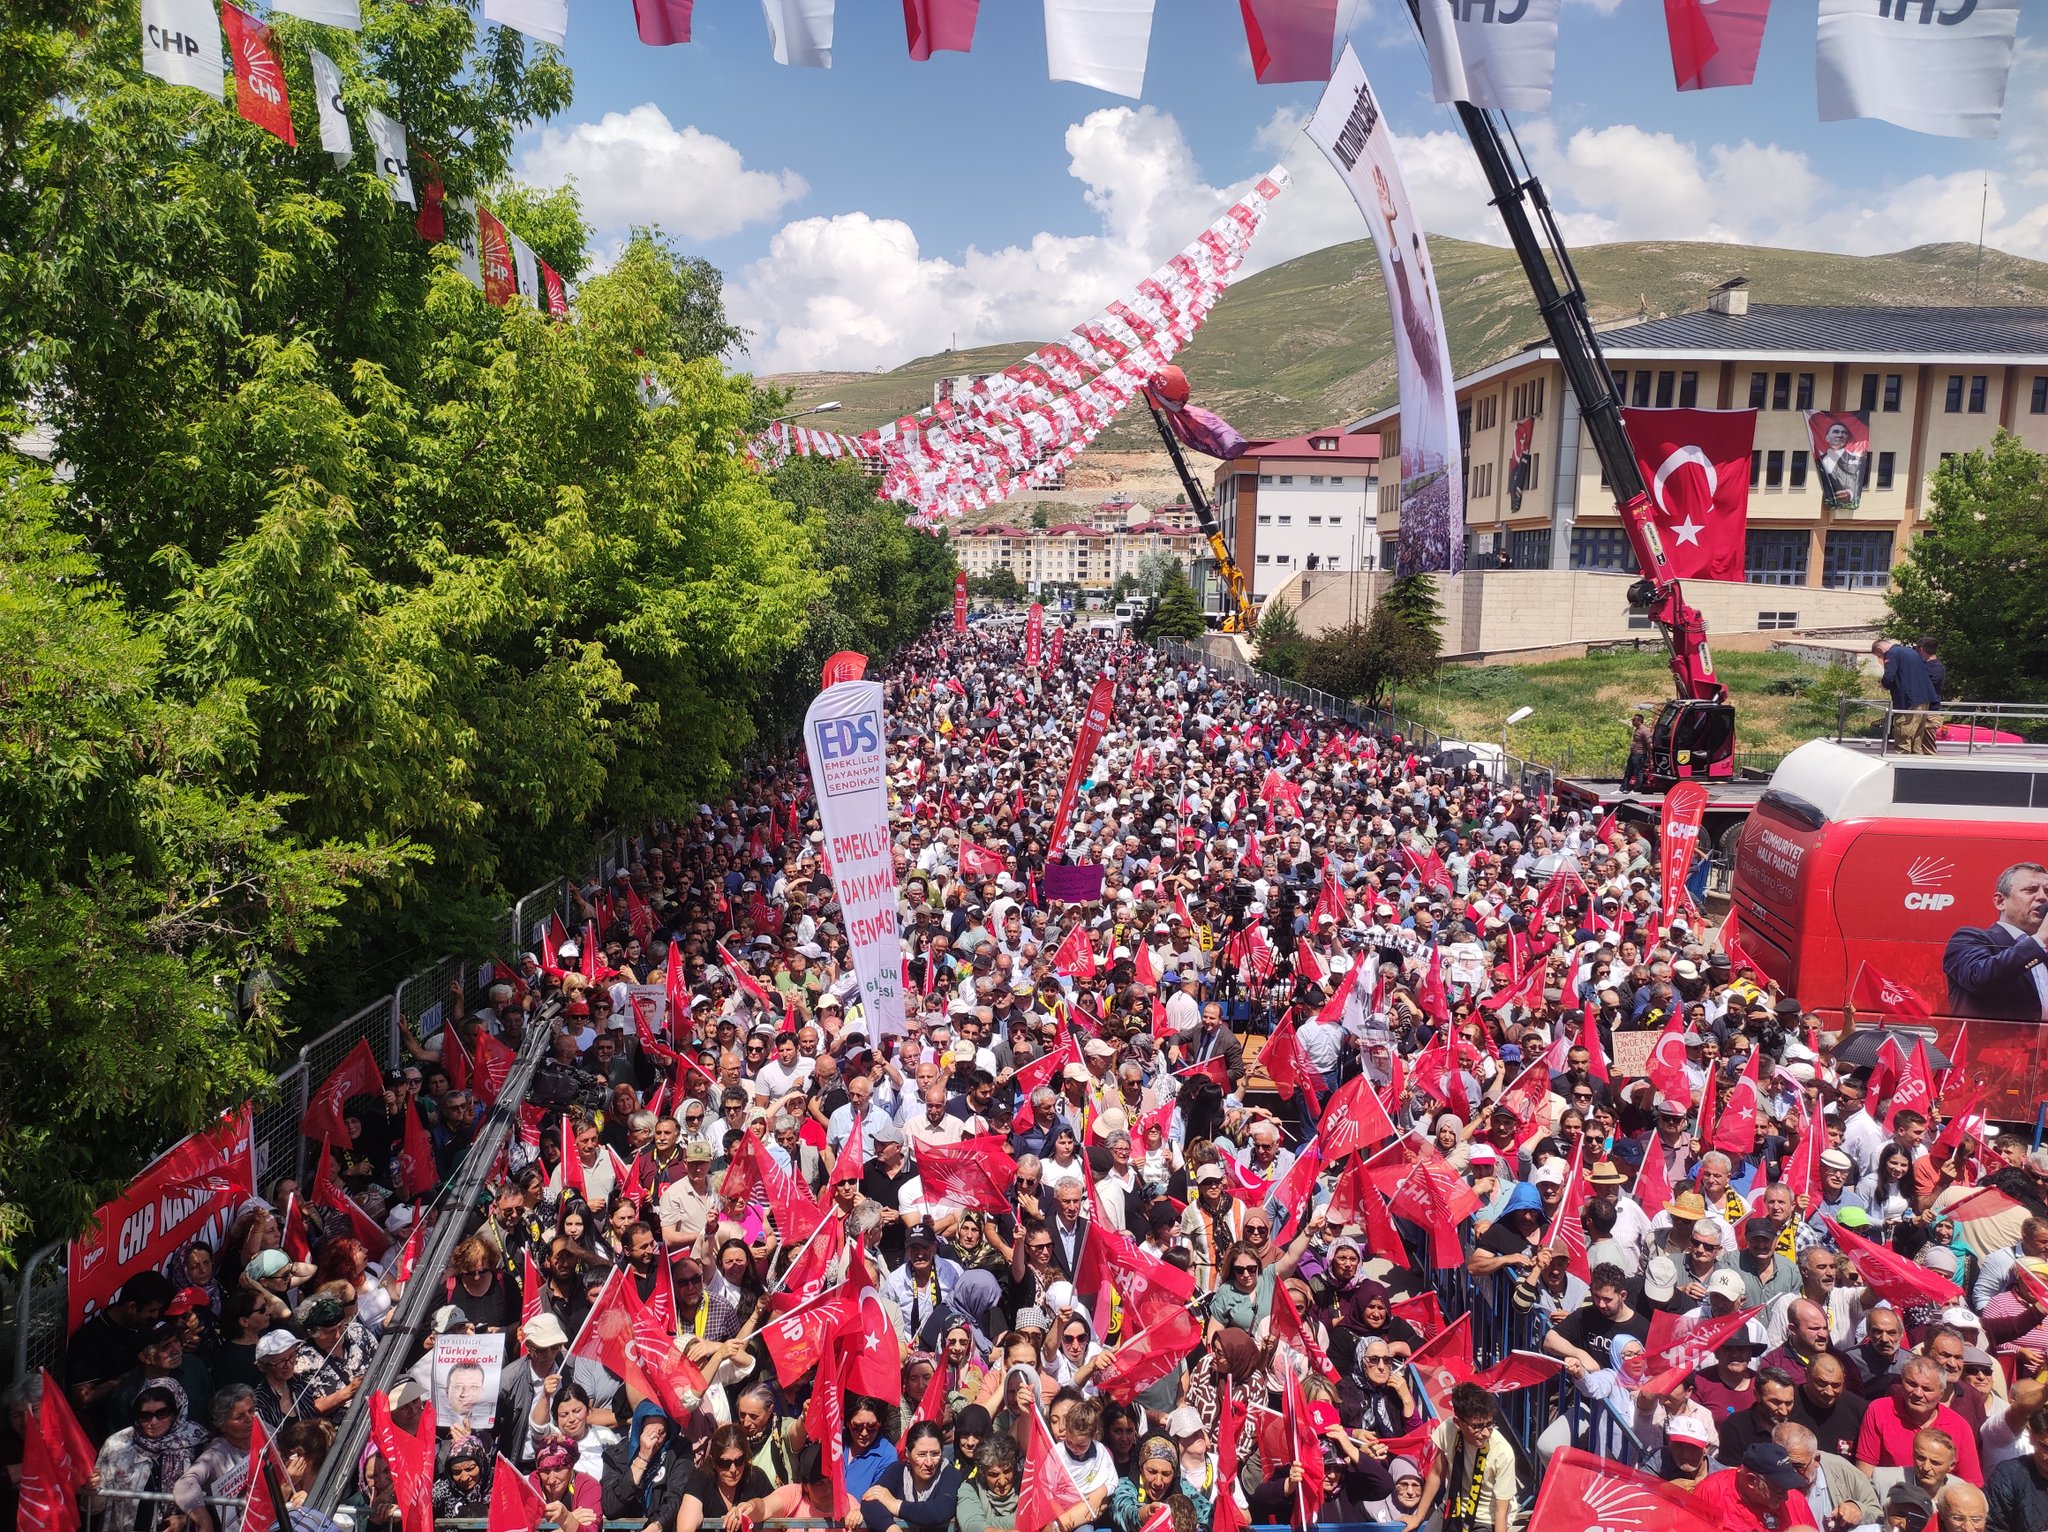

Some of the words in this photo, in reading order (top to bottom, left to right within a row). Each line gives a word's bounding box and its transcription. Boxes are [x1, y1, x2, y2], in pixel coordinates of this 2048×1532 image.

[148, 24, 199, 57] CHP
[249, 76, 281, 106] CHP
[384, 157, 410, 178] CH
[817, 714, 878, 760] EDS
[825, 754, 879, 771] EMEKLİLER
[1667, 821, 1699, 840] CHP
[1762, 829, 1804, 861] CUMHURİYET
[1757, 846, 1772, 868] HALK
[1772, 854, 1799, 879] PARTİSİ
[1904, 892, 1955, 911] CHP
[118, 1202, 154, 1265] CHP
[83, 1246, 104, 1270] CHP
[438, 1355, 498, 1364] kazanacak!
[439, 1346, 478, 1357] Türkiye
